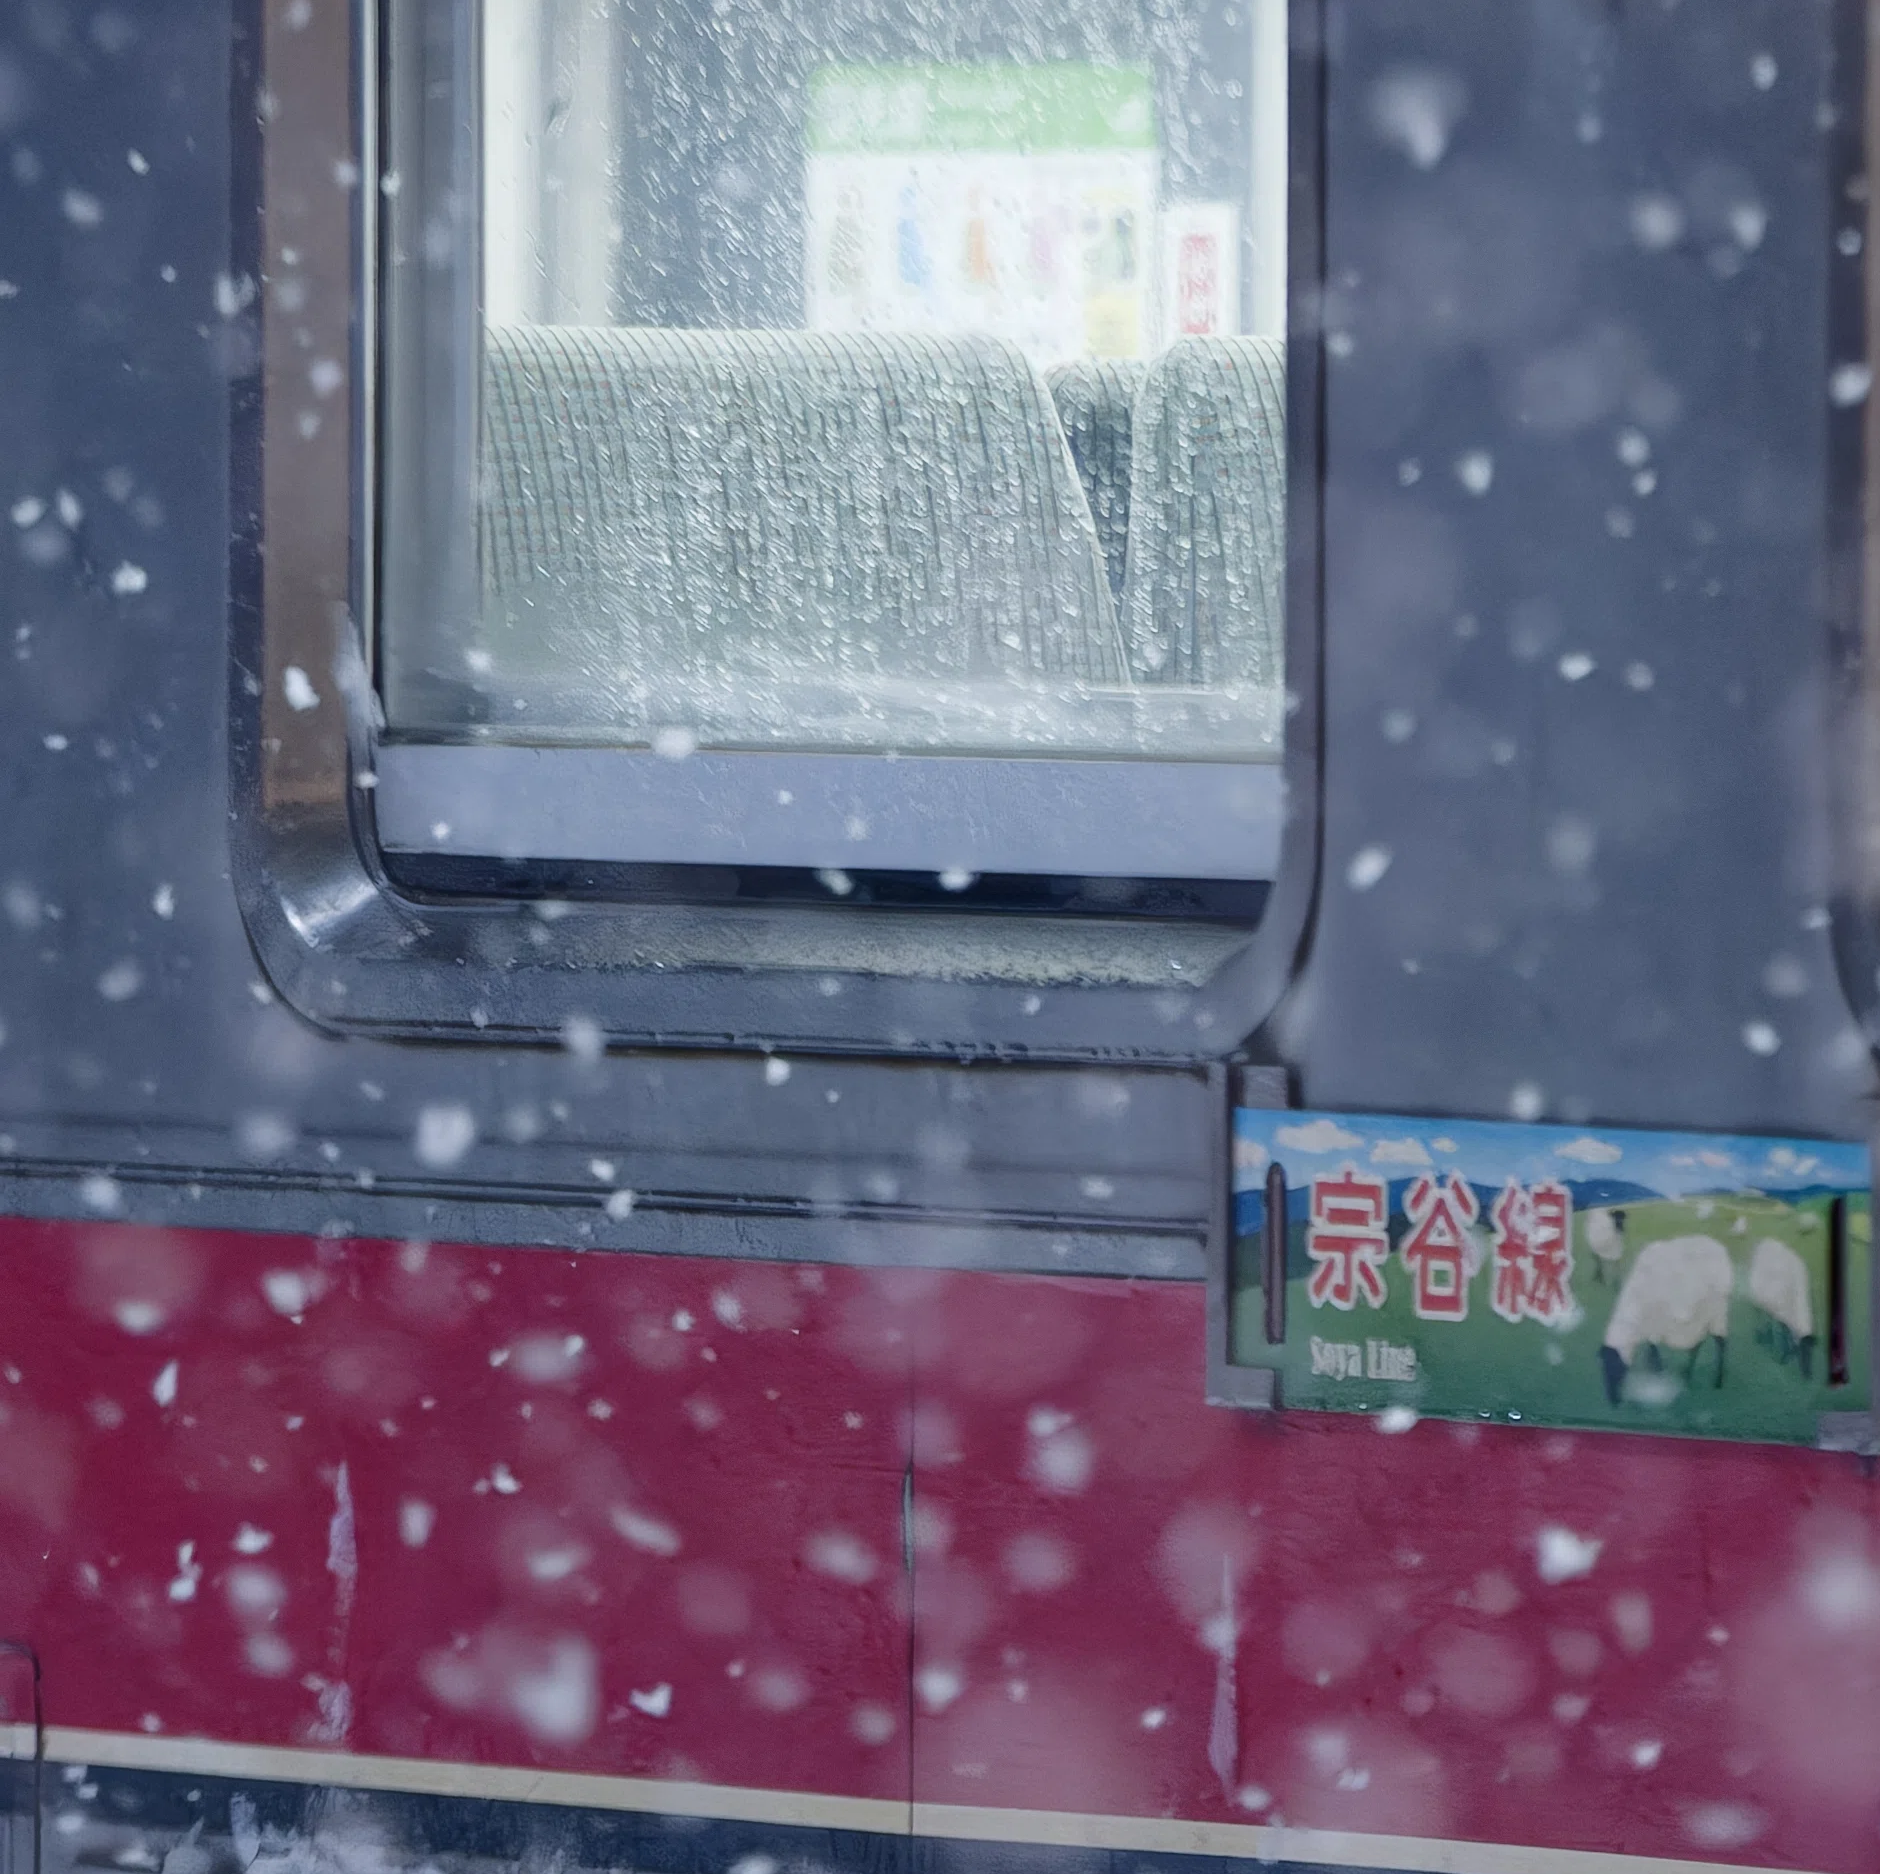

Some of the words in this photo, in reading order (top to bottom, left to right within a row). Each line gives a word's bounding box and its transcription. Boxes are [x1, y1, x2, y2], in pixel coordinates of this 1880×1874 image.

[1308, 1163, 1573, 1325] 宗谷線
[1309, 1335, 1362, 1382] Soya
[1366, 1337, 1417, 1382] Line
